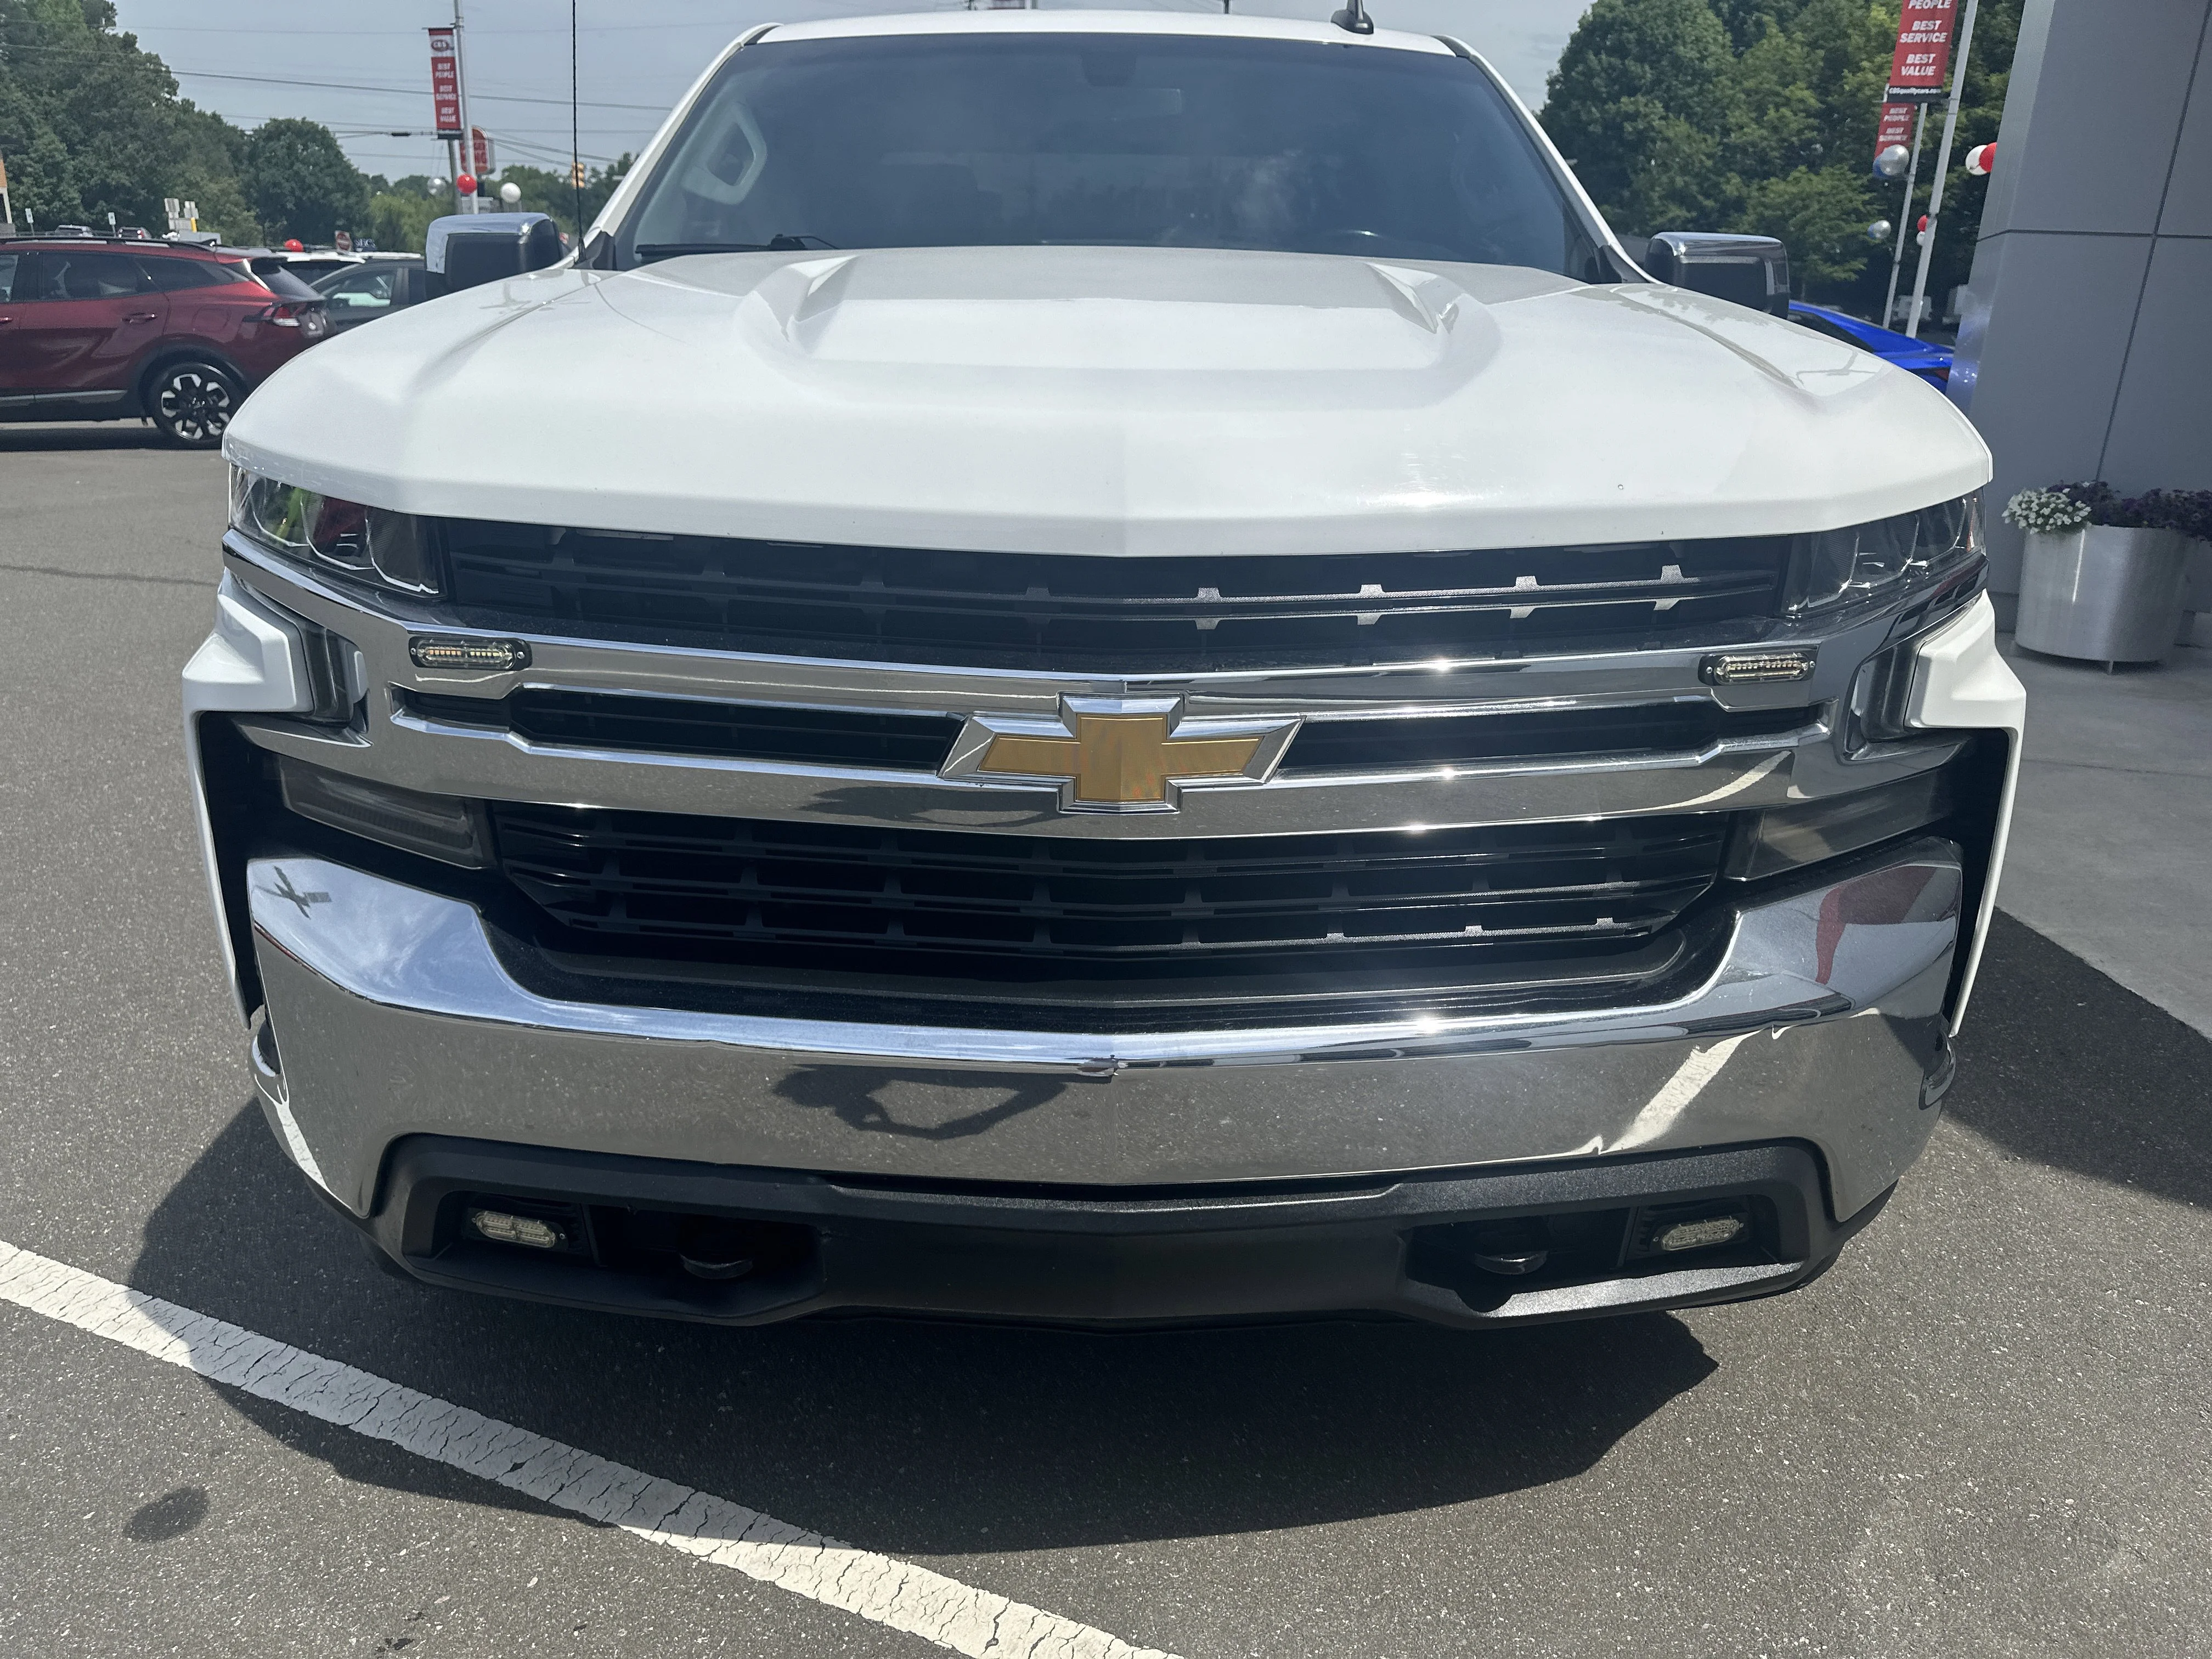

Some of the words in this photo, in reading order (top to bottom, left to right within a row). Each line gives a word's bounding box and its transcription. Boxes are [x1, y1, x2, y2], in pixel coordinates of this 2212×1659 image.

[1908, 0, 1951, 9] PEOPLE
[1912, 20, 1942, 31] BEST
[1900, 32, 1948, 43] SERVICE
[1906, 54, 1936, 64] BEST
[1900, 66, 1937, 76] VALUE
